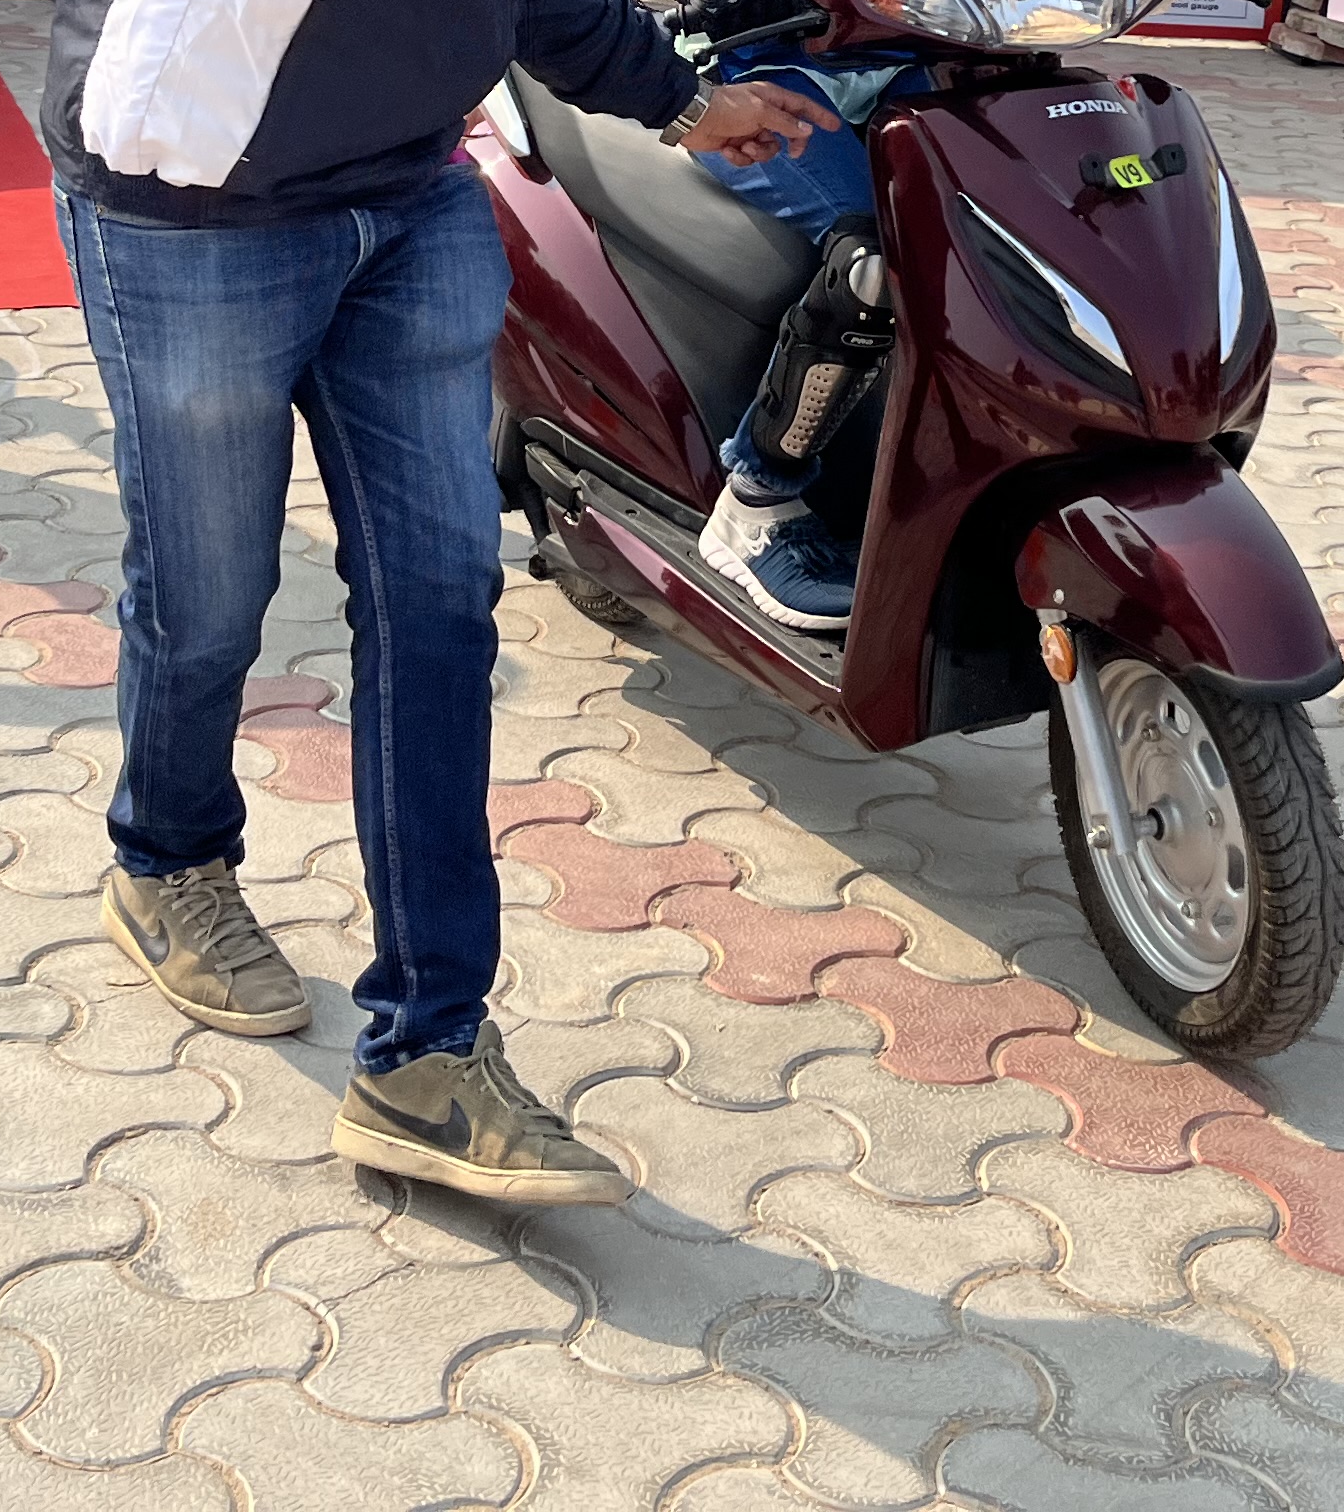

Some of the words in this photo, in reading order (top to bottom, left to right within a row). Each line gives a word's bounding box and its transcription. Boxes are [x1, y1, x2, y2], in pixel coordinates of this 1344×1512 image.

[1190, 2, 1220, 11] gauge
[1045, 99, 1129, 120] HONDA
[1113, 162, 1143, 185] V9
